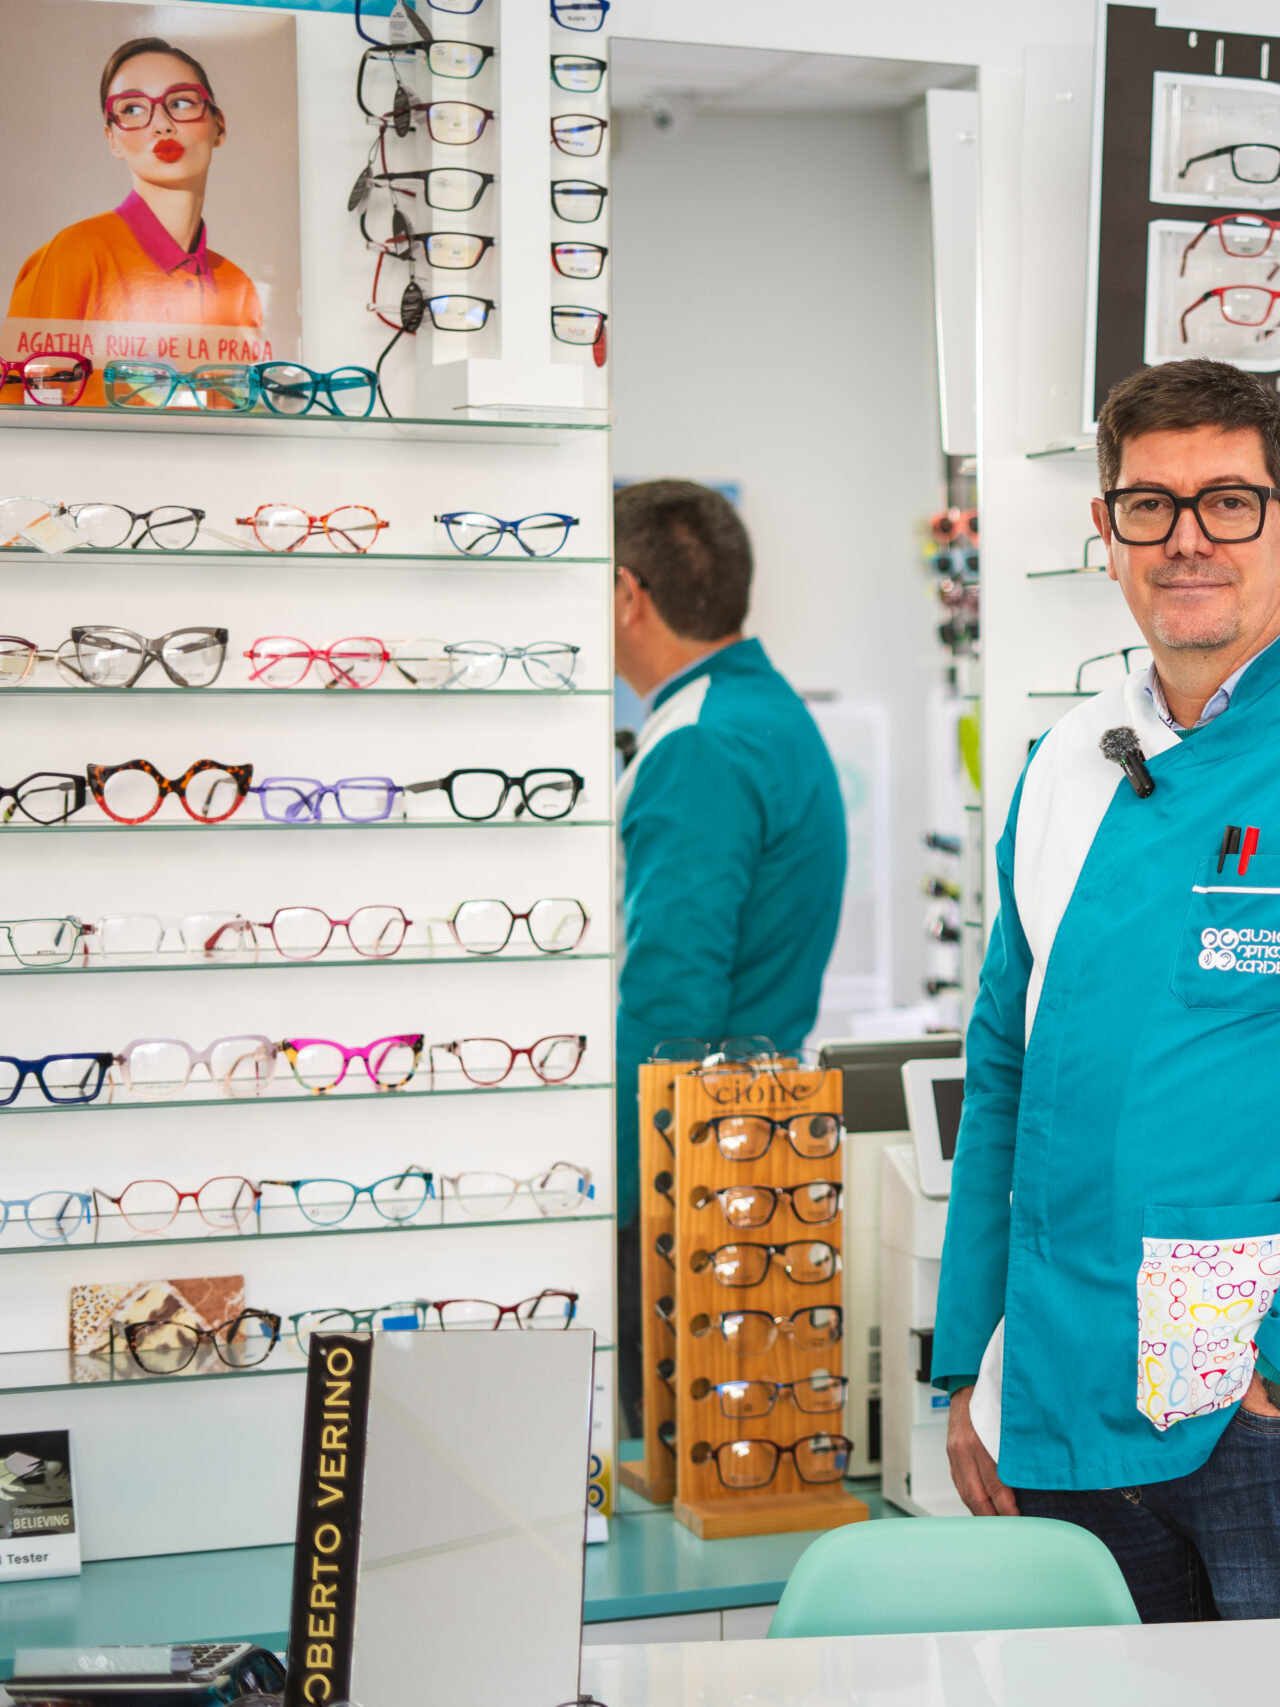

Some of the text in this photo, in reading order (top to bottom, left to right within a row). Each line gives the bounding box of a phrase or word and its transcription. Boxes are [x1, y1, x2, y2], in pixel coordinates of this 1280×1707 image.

[17, 332, 274, 362] AGATHA RUIZ DE LA PRADA
[715, 1080, 812, 1105] cione
[316, 1347, 353, 1508] VERINO
[13, 1513, 70, 1530] BELIEVING
[6, 1553, 49, 1566] Tester
